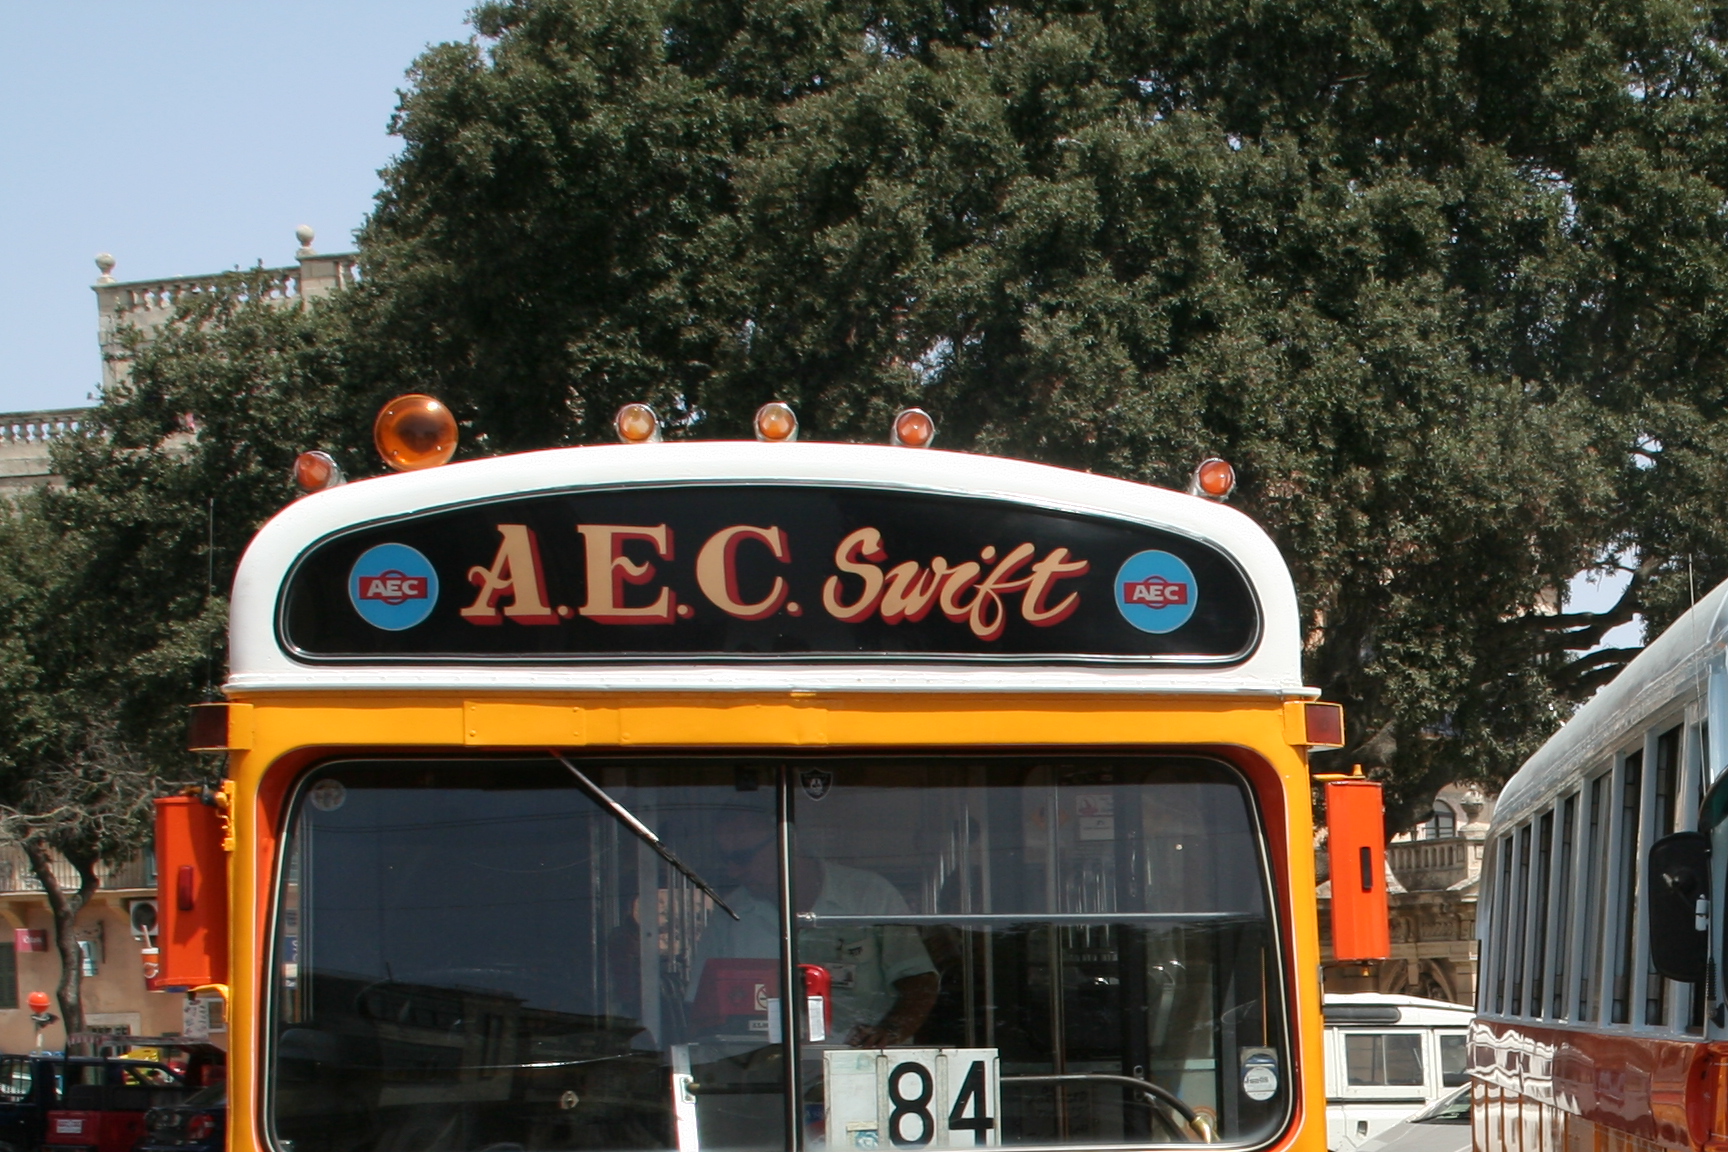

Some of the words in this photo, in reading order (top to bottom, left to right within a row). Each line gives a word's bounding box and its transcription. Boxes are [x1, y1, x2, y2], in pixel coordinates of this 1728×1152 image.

[366, 577, 420, 597] AEC
[821, 526, 1090, 641] Swift
[1132, 584, 1180, 602] AEC
[888, 1060, 995, 1148] 84
